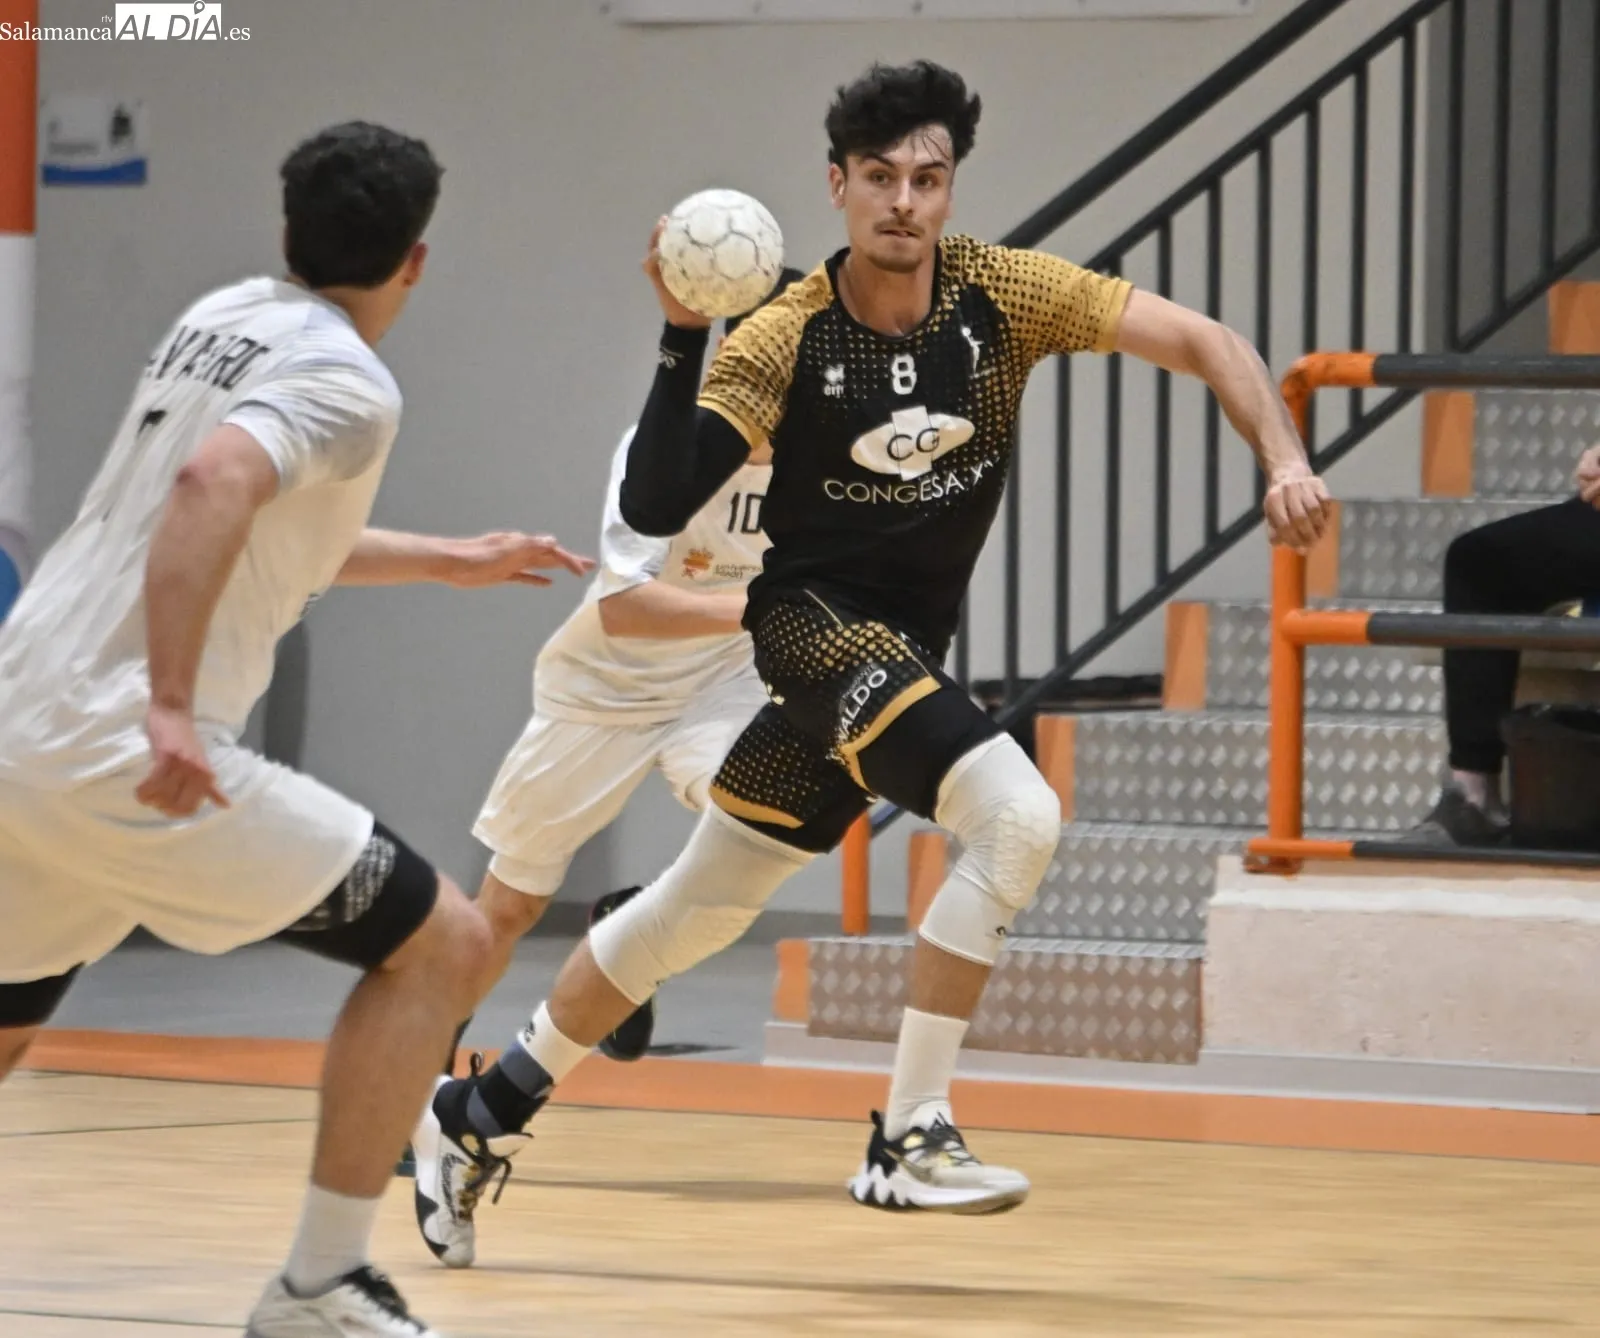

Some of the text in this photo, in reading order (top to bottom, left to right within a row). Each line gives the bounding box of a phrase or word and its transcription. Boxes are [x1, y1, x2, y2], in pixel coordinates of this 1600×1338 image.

[890, 353, 917, 395] 8
[824, 472, 965, 504] CONGESA
[727, 492, 764, 534] 10
